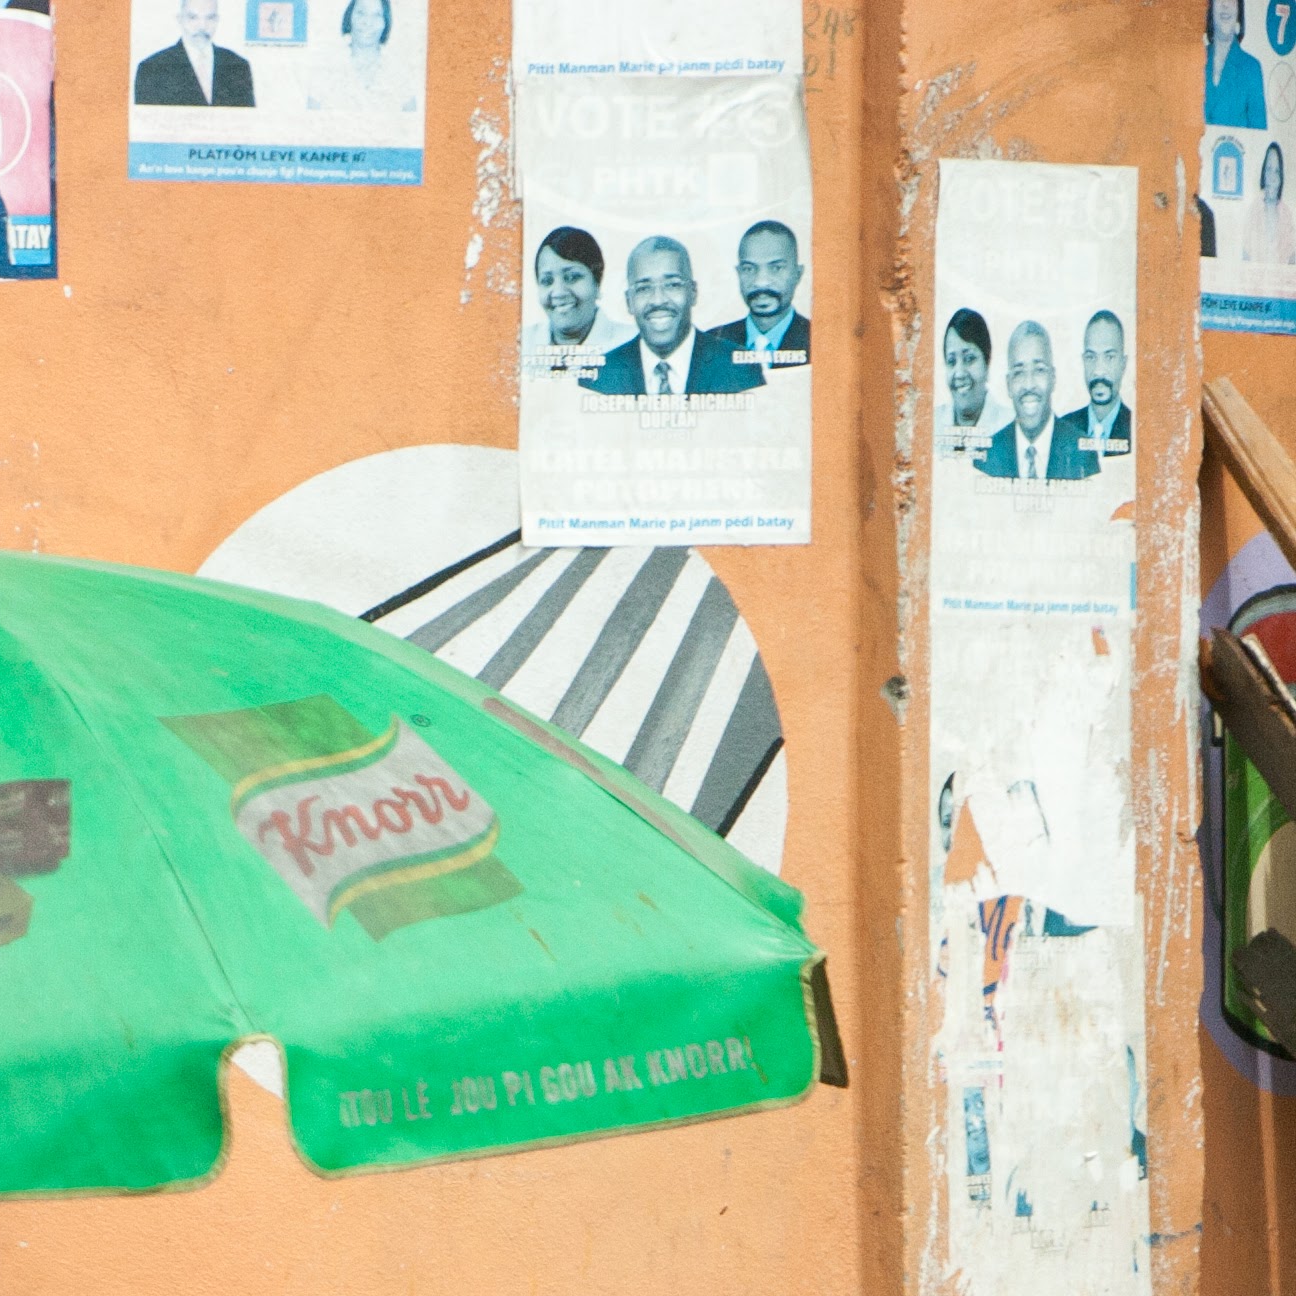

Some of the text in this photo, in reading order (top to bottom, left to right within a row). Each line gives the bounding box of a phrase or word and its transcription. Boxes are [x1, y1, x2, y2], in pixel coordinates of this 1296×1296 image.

[1274, 4, 1291, 45] 7
[559, 62, 615, 74] Manman
[619, 61, 654, 73] Marie
[747, 58, 785, 74] batay
[261, 149, 295, 162] LEVE
[299, 150, 349, 163] KANPE
[8, 223, 51, 249] ATAY
[582, 393, 756, 413] JOSEPH PIERRE RICHARD
[569, 517, 625, 529] Manman
[629, 516, 666, 529] Marie
[670, 518, 686, 531] pa
[688, 515, 721, 531] janm
[757, 514, 795, 530] batay
[258, 773, 472, 877] Knorr
[501, 1069, 537, 1108] PI
